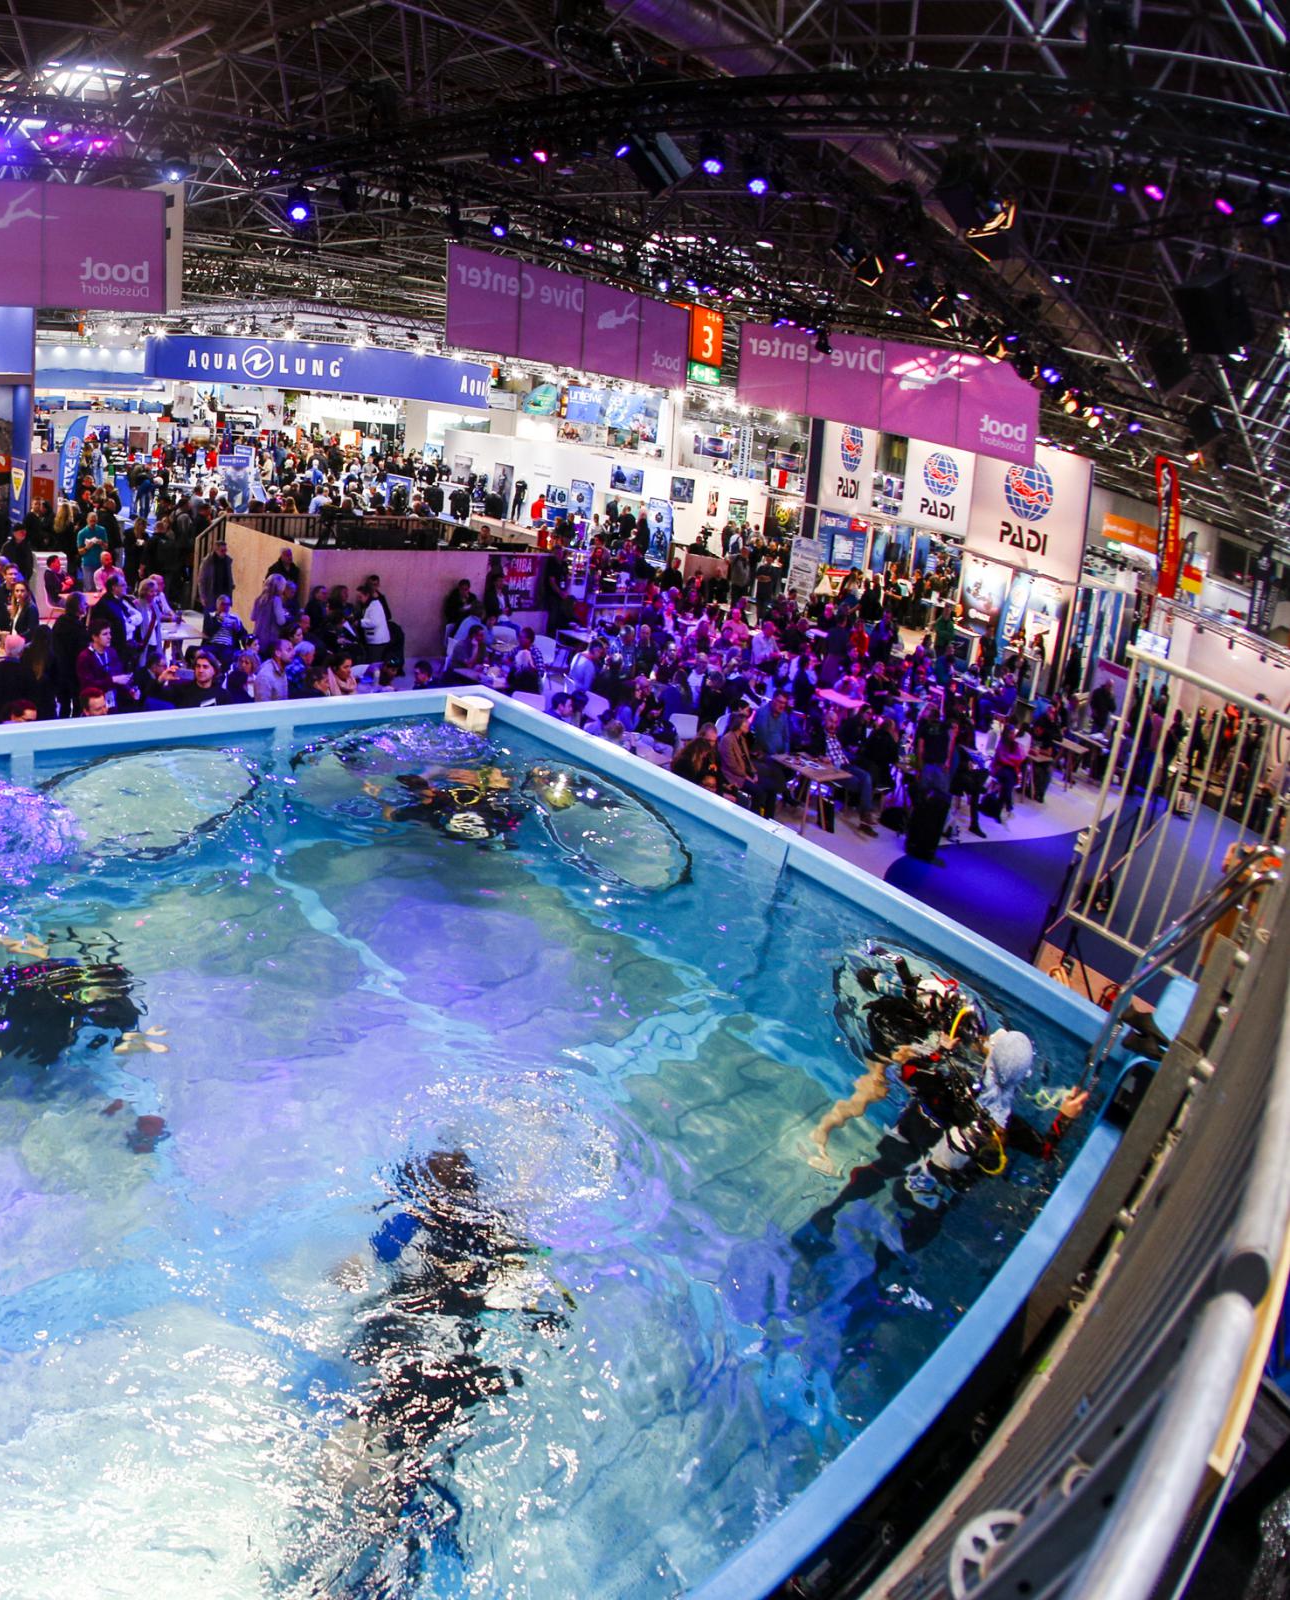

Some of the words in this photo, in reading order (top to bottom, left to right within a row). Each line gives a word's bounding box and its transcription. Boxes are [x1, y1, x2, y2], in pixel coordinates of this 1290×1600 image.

[701, 325, 714, 358] 3
[187, 349, 237, 371] AQUA
[837, 476, 860, 500] PADI
[920, 498, 955, 521] PADI
[999, 521, 1048, 556] PADI
